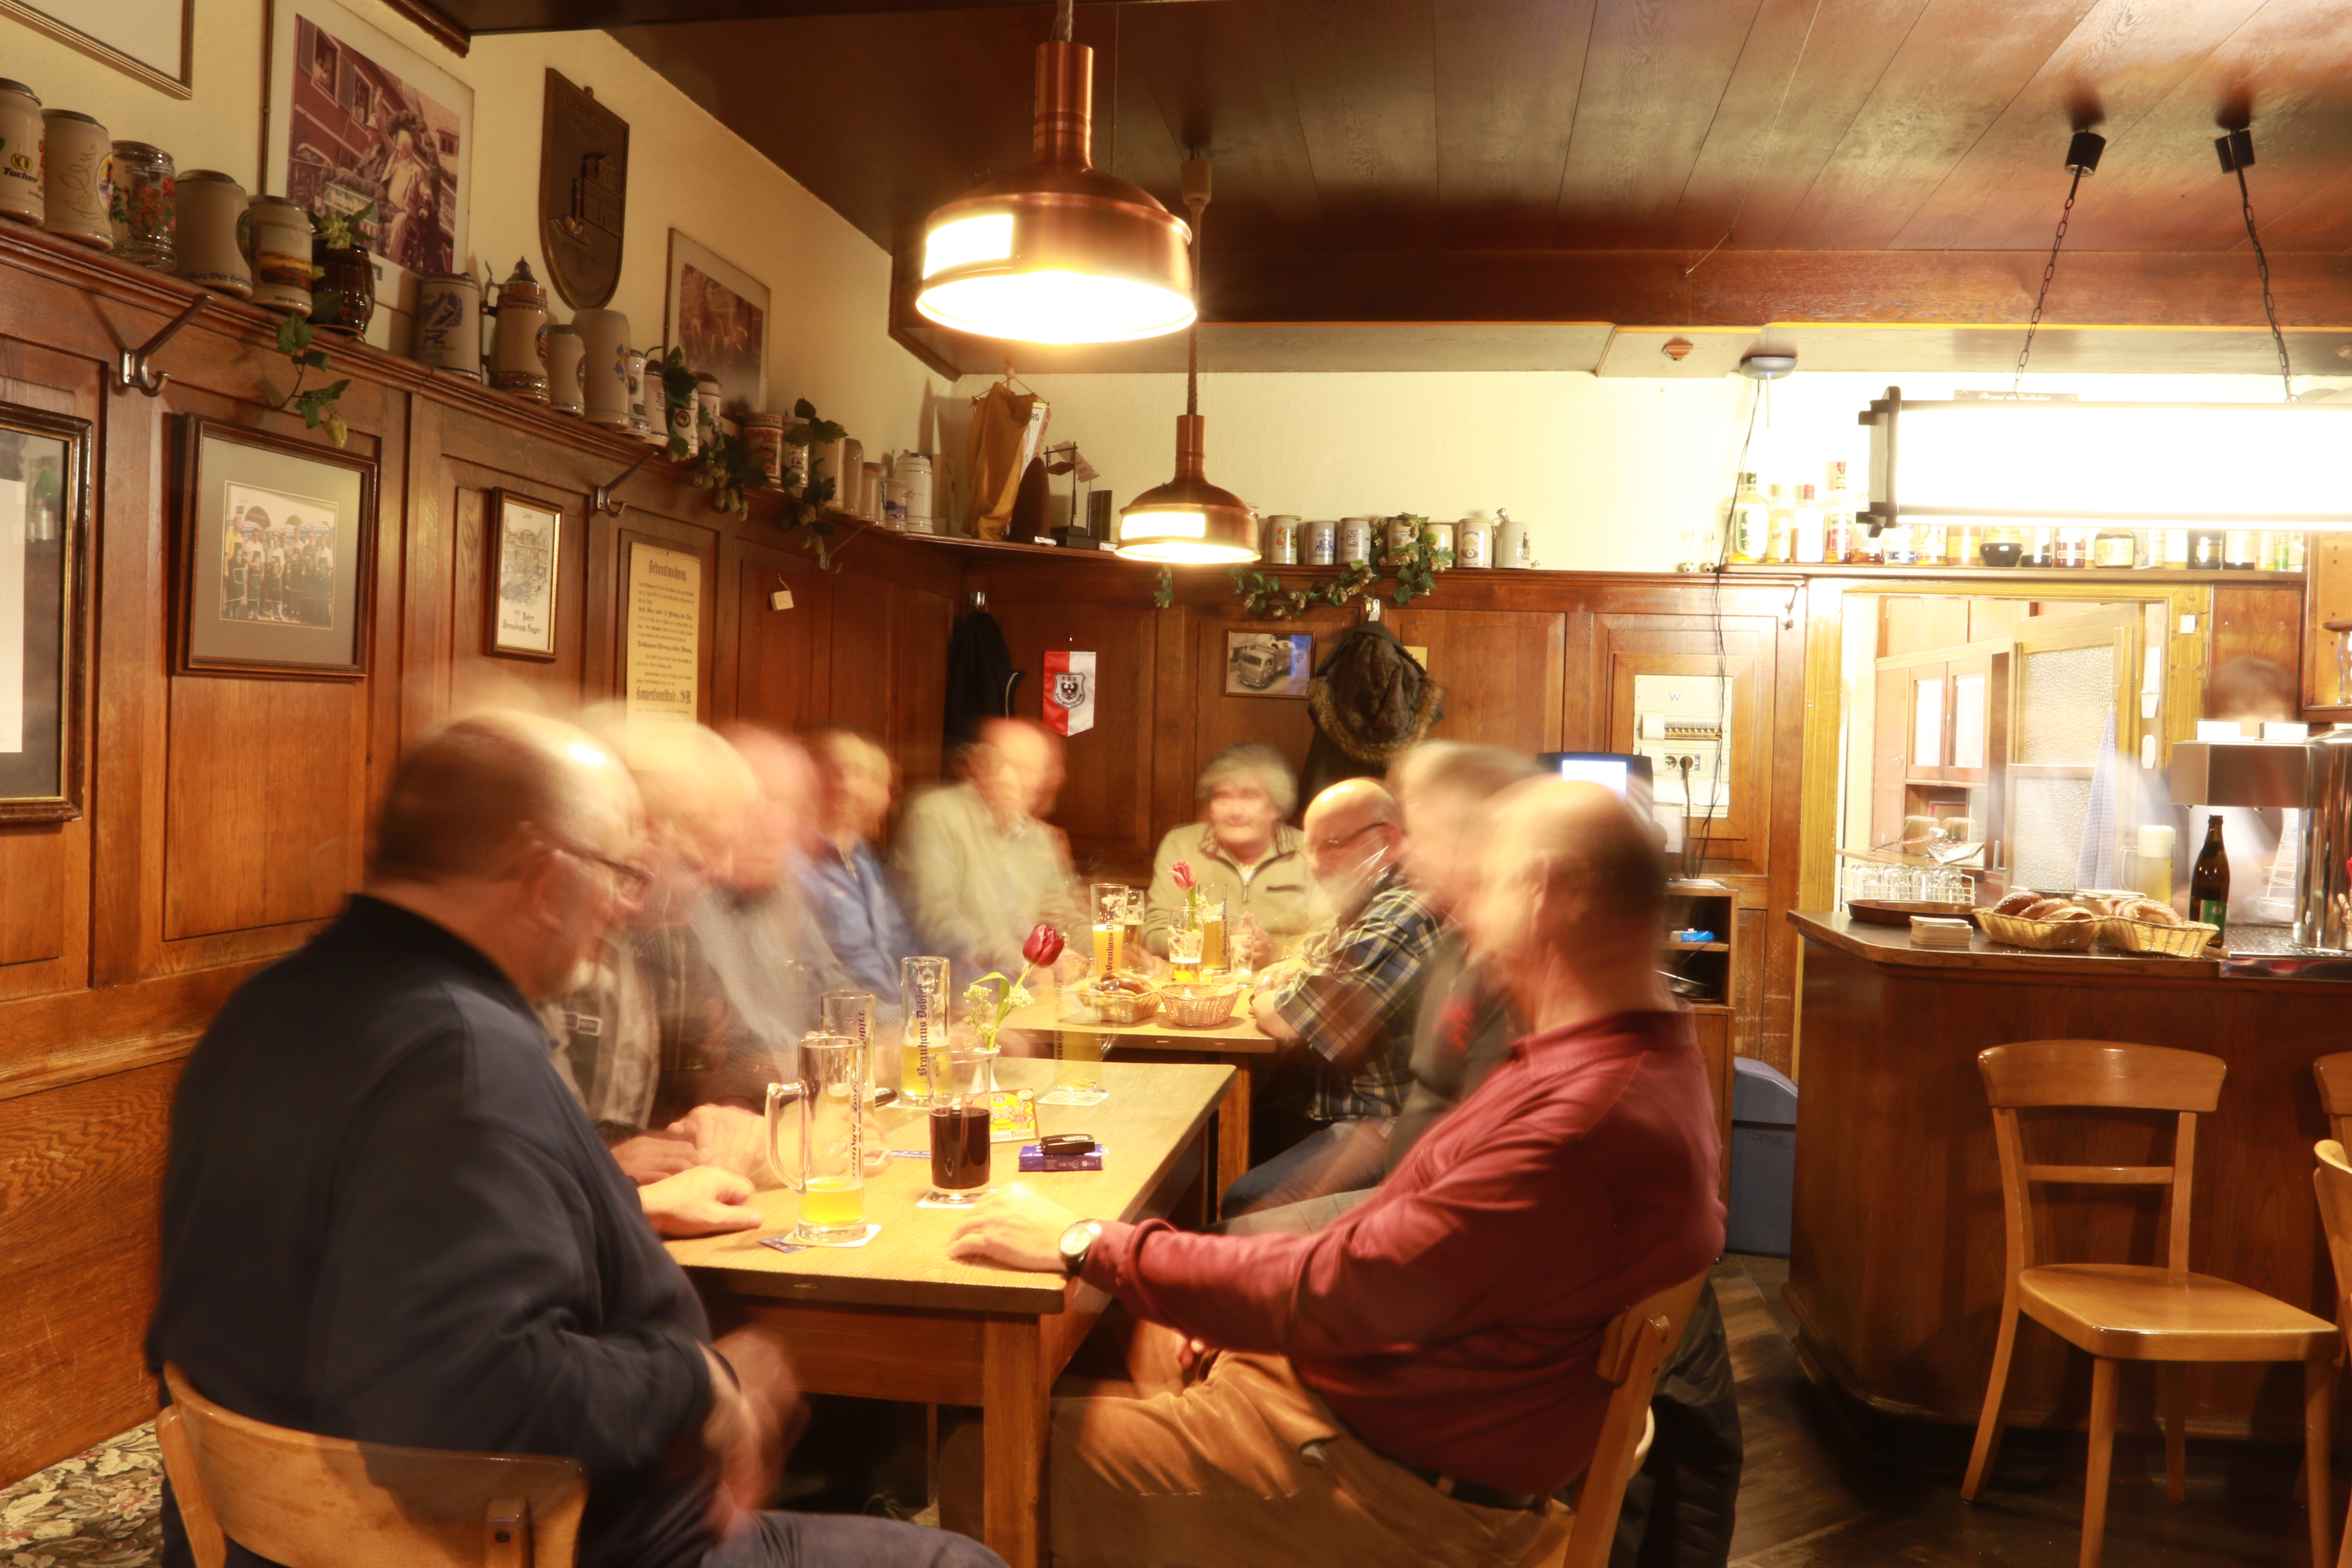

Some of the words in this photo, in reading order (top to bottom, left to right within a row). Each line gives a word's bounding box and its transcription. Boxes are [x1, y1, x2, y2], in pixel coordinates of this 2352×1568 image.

[3, 167, 38, 183] Tucher
[1062, 693, 1083, 706] WINDSHEIM
[1669, 692, 1681, 701] W
[1105, 933, 1114, 971] Brauhaus
[916, 983, 930, 1019] Döbler
[917, 1022, 930, 1077] Brauhaus
[1011, 1131, 1032, 1139] Döbler
